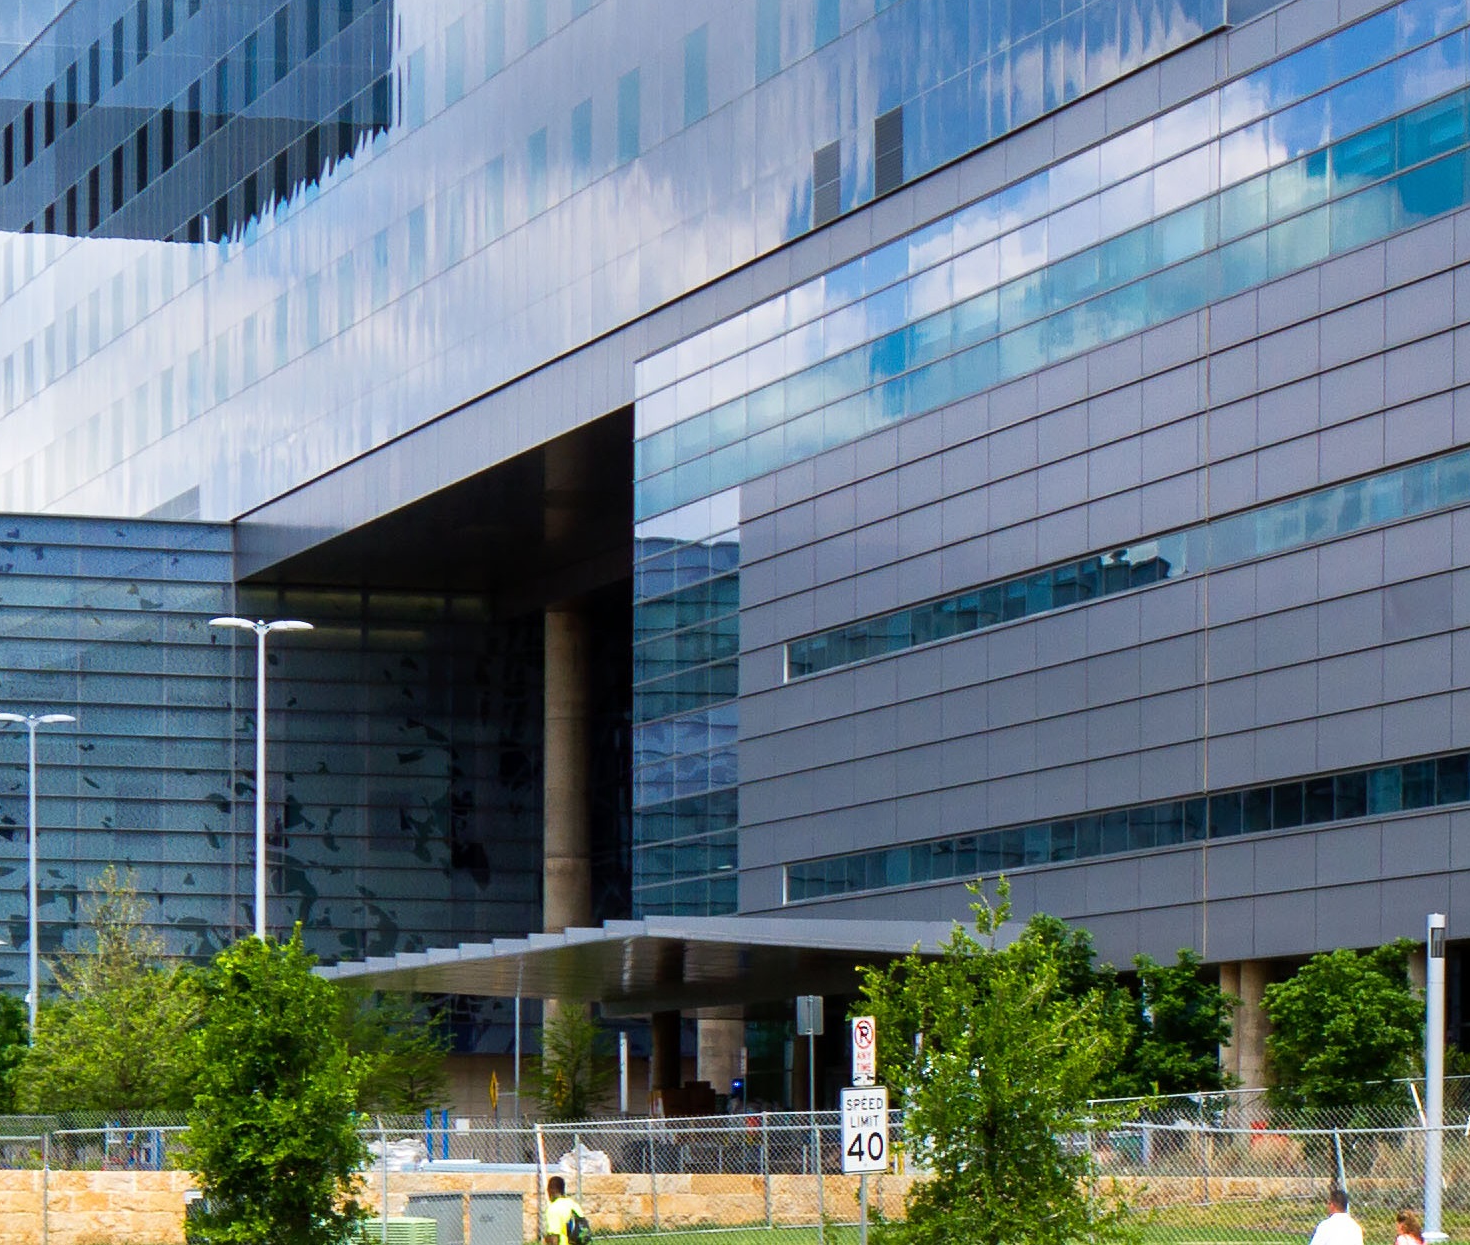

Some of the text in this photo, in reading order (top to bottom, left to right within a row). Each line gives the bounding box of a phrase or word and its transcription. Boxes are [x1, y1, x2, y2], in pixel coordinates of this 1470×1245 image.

[846, 1097, 883, 1111] SPEED
[850, 1114, 879, 1128] LIMIT
[847, 1131, 884, 1162] 40
